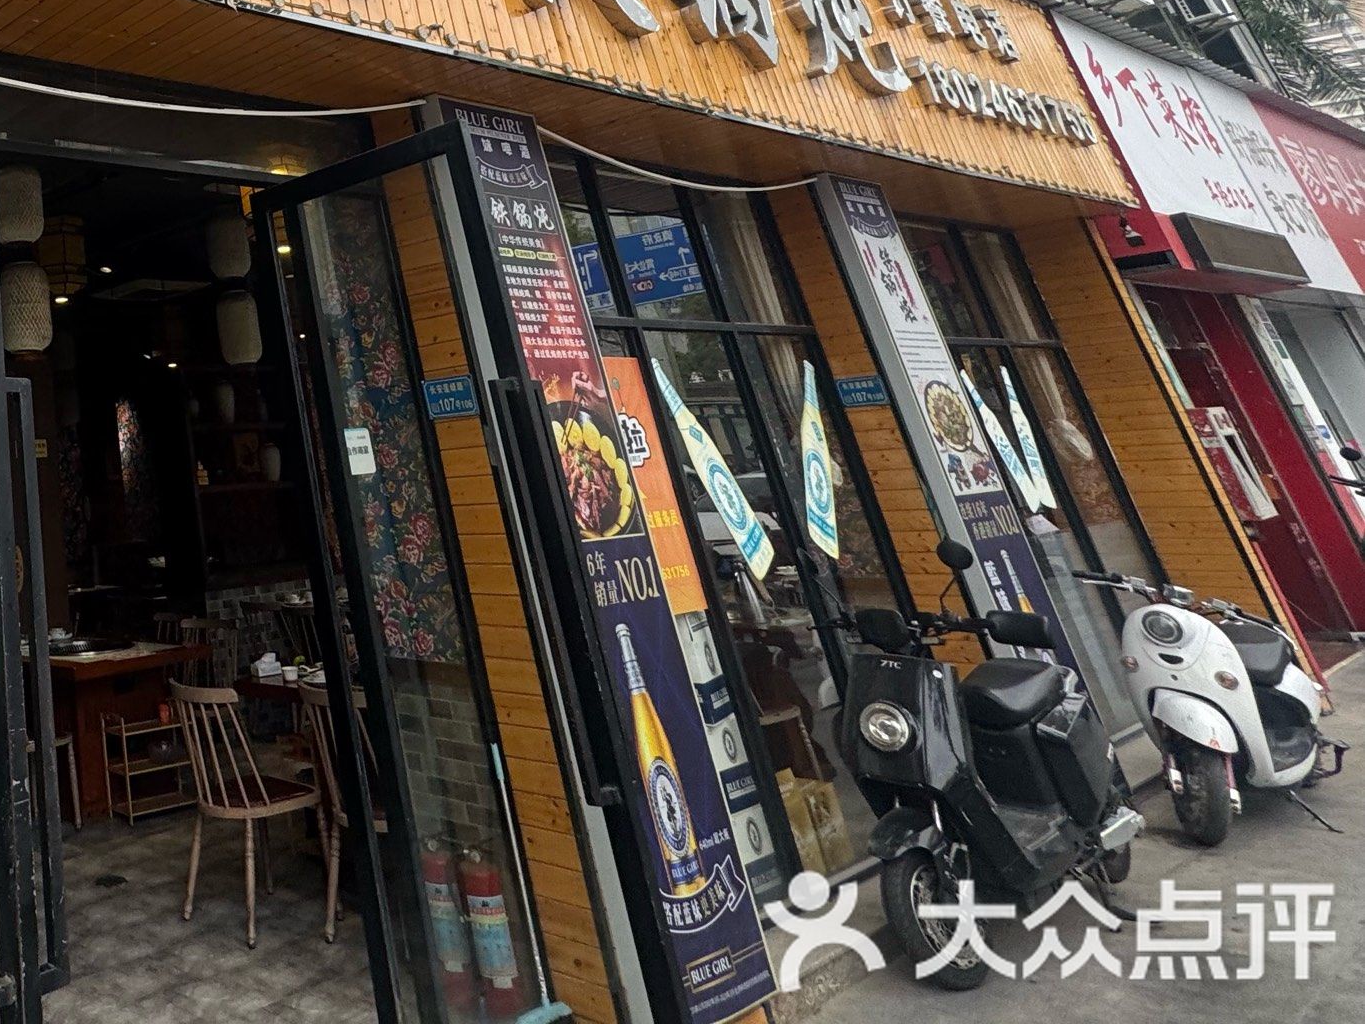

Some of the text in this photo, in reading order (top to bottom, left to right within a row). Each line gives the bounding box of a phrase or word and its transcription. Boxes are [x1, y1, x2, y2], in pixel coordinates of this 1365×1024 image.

[915, 56, 1099, 145] 18024631756
[1082, 41, 1225, 159] 乡下菜馆
[491, 115, 525, 136] GIRL
[490, 195, 555, 231] 铁锅炖
[586, 550, 608, 577] 6年
[614, 554, 661, 604] NO.1
[593, 580, 619, 608] 销量
[690, 955, 733, 986] BLUE GIRL
